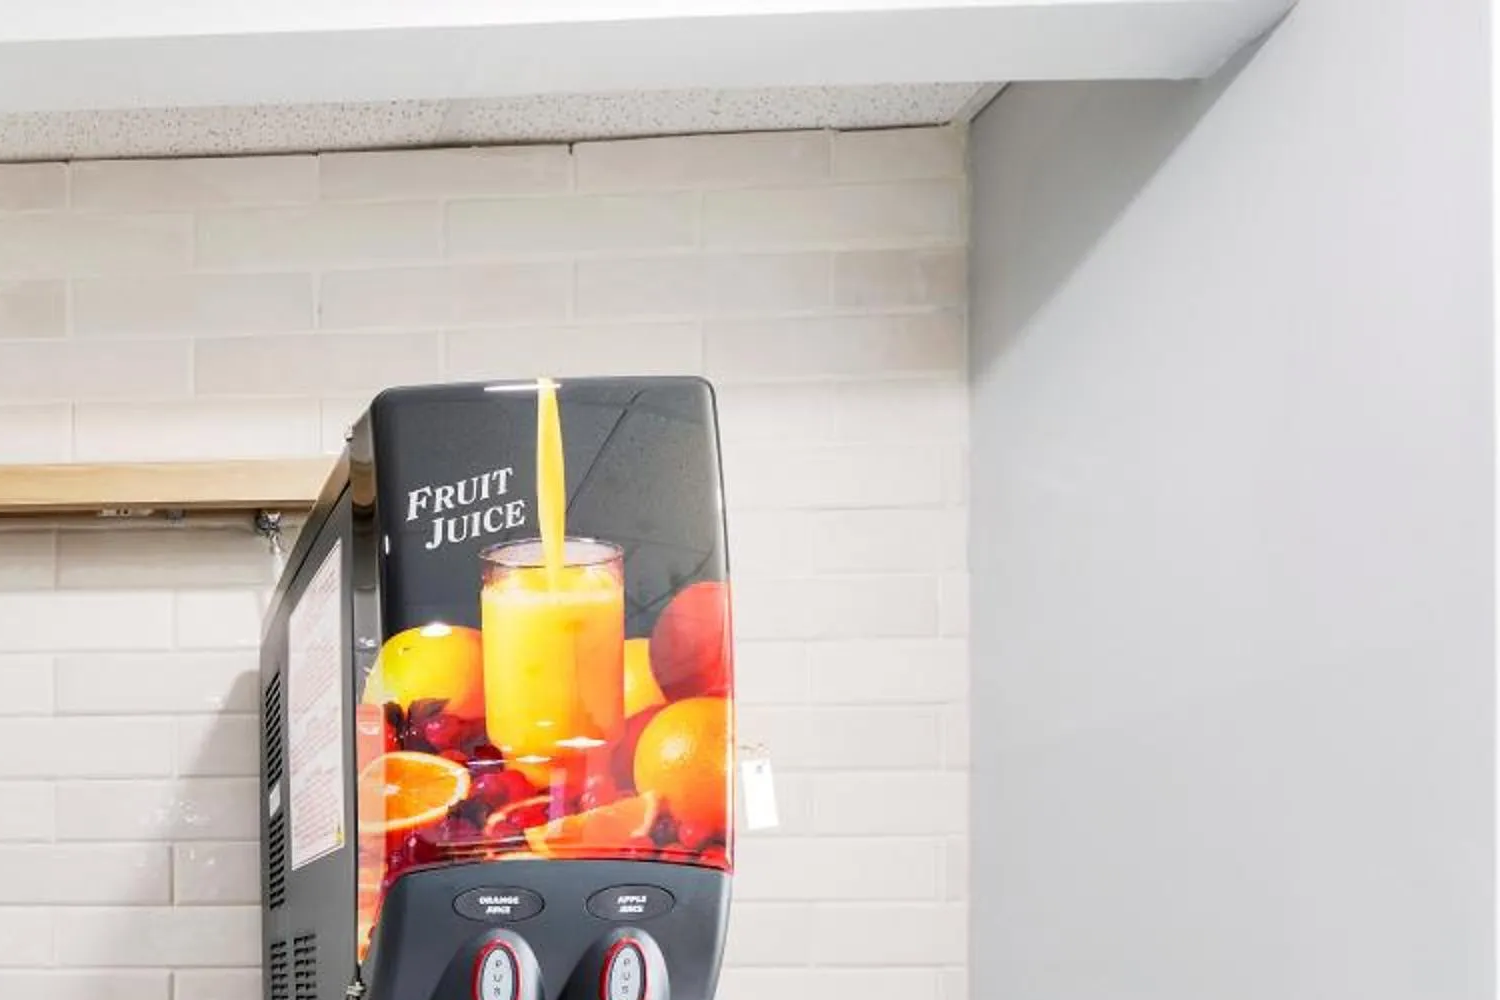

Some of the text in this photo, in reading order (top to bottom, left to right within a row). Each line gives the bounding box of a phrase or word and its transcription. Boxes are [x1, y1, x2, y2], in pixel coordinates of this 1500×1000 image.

[405, 467, 513, 522] FRUIT
[425, 499, 525, 550] JUICE
[479, 895, 519, 905] ORANGE
[617, 895, 647, 904] APPLE
